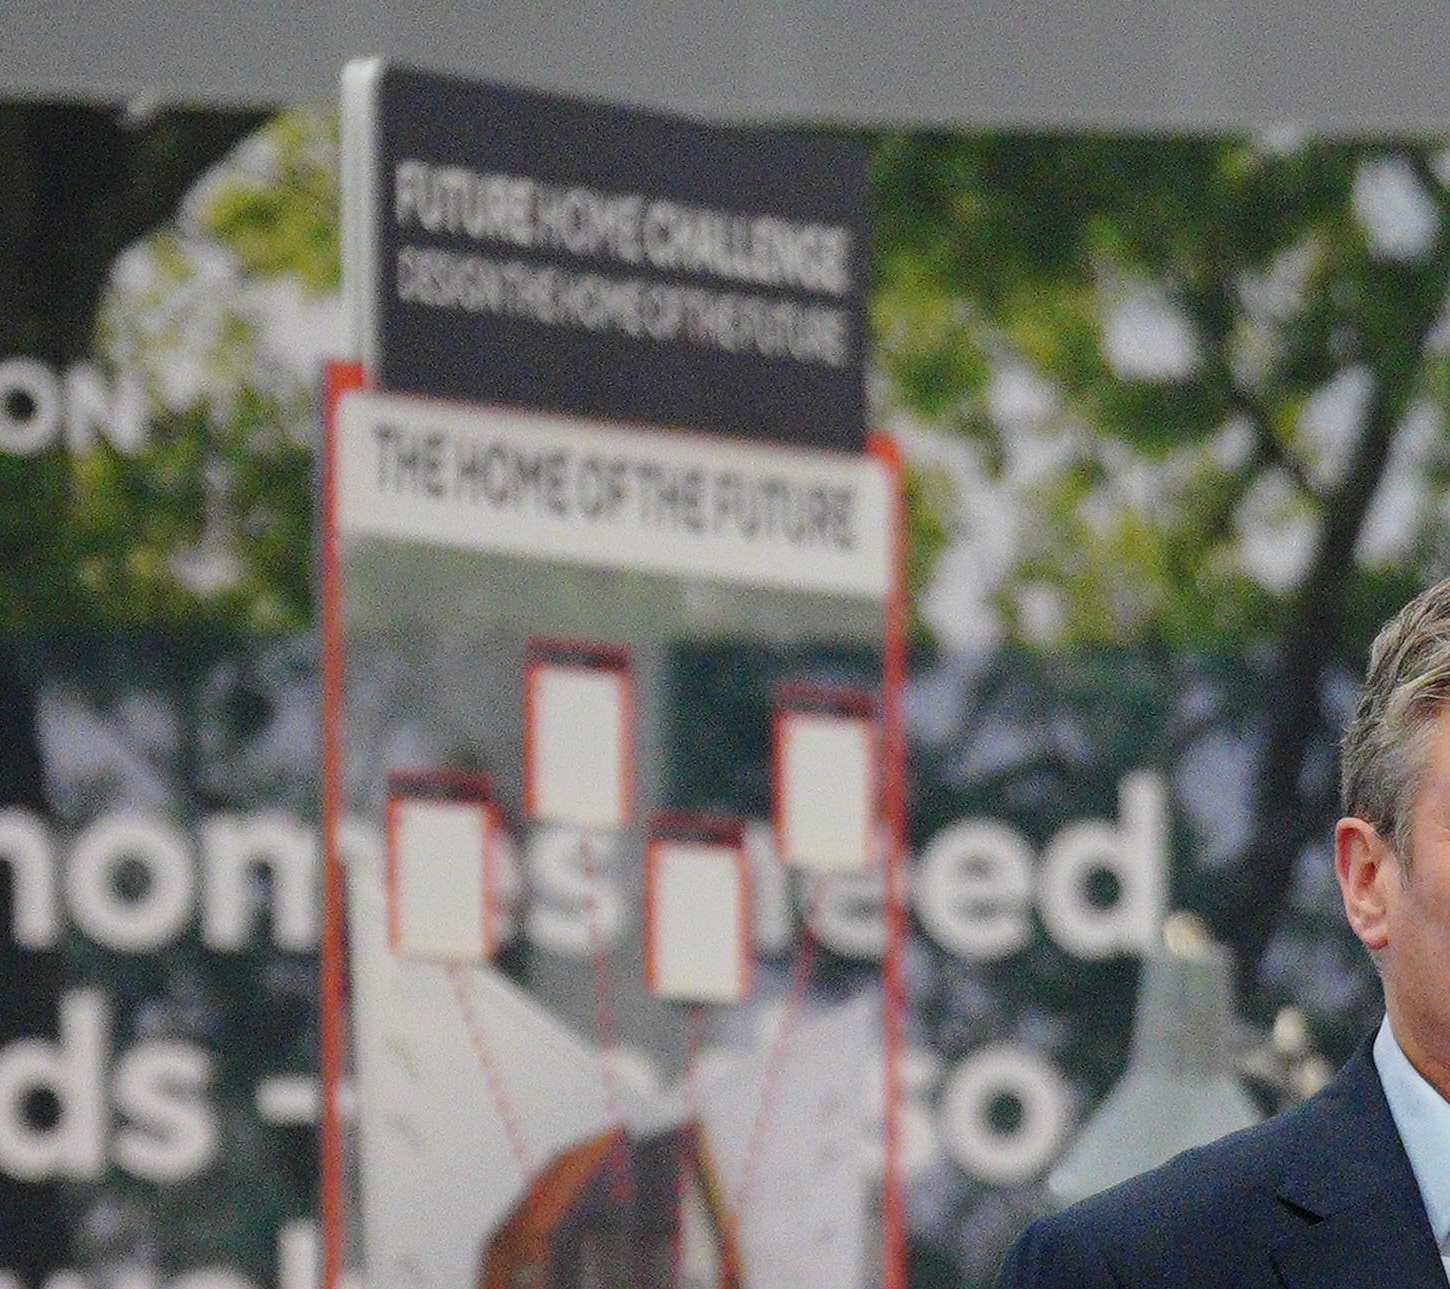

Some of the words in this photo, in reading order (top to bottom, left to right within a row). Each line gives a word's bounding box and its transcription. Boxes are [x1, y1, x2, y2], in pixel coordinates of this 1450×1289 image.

[396, 160, 534, 246] FUTURE
[535, 184, 645, 264] HOME
[645, 200, 854, 296] CHALLENGE
[373, 424, 445, 500] THE
[454, 435, 569, 515] HOME
[578, 448, 630, 522] OF
[637, 458, 705, 535] THE
[714, 465, 858, 551] FUTURE
